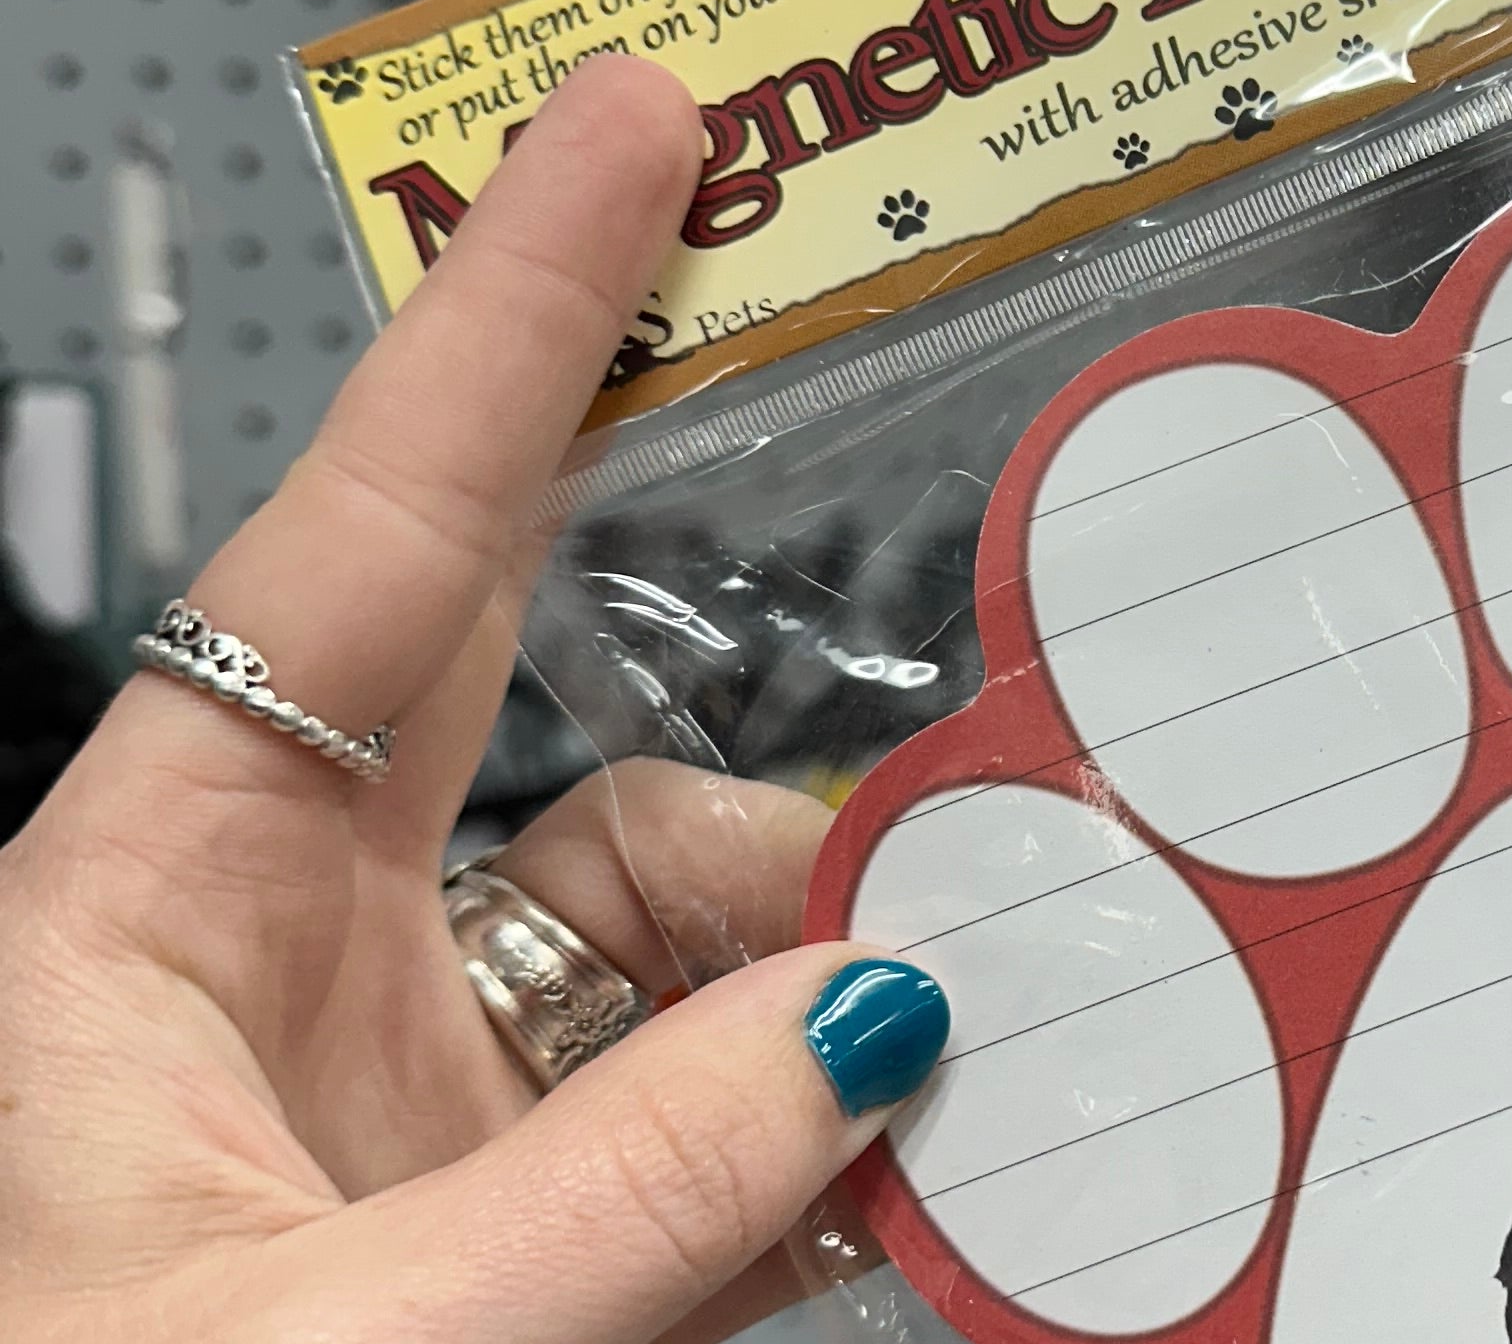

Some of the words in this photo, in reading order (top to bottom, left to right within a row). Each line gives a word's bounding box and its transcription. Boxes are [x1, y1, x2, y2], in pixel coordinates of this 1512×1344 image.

[378, 31, 481, 102] Stick
[484, 1, 593, 60] them
[399, 108, 441, 146] or
[448, 69, 525, 141] put
[643, 11, 694, 51] on
[980, 79, 1103, 162] with
[1112, 0, 1328, 114] adhesive
[694, 297, 780, 347] Pets
